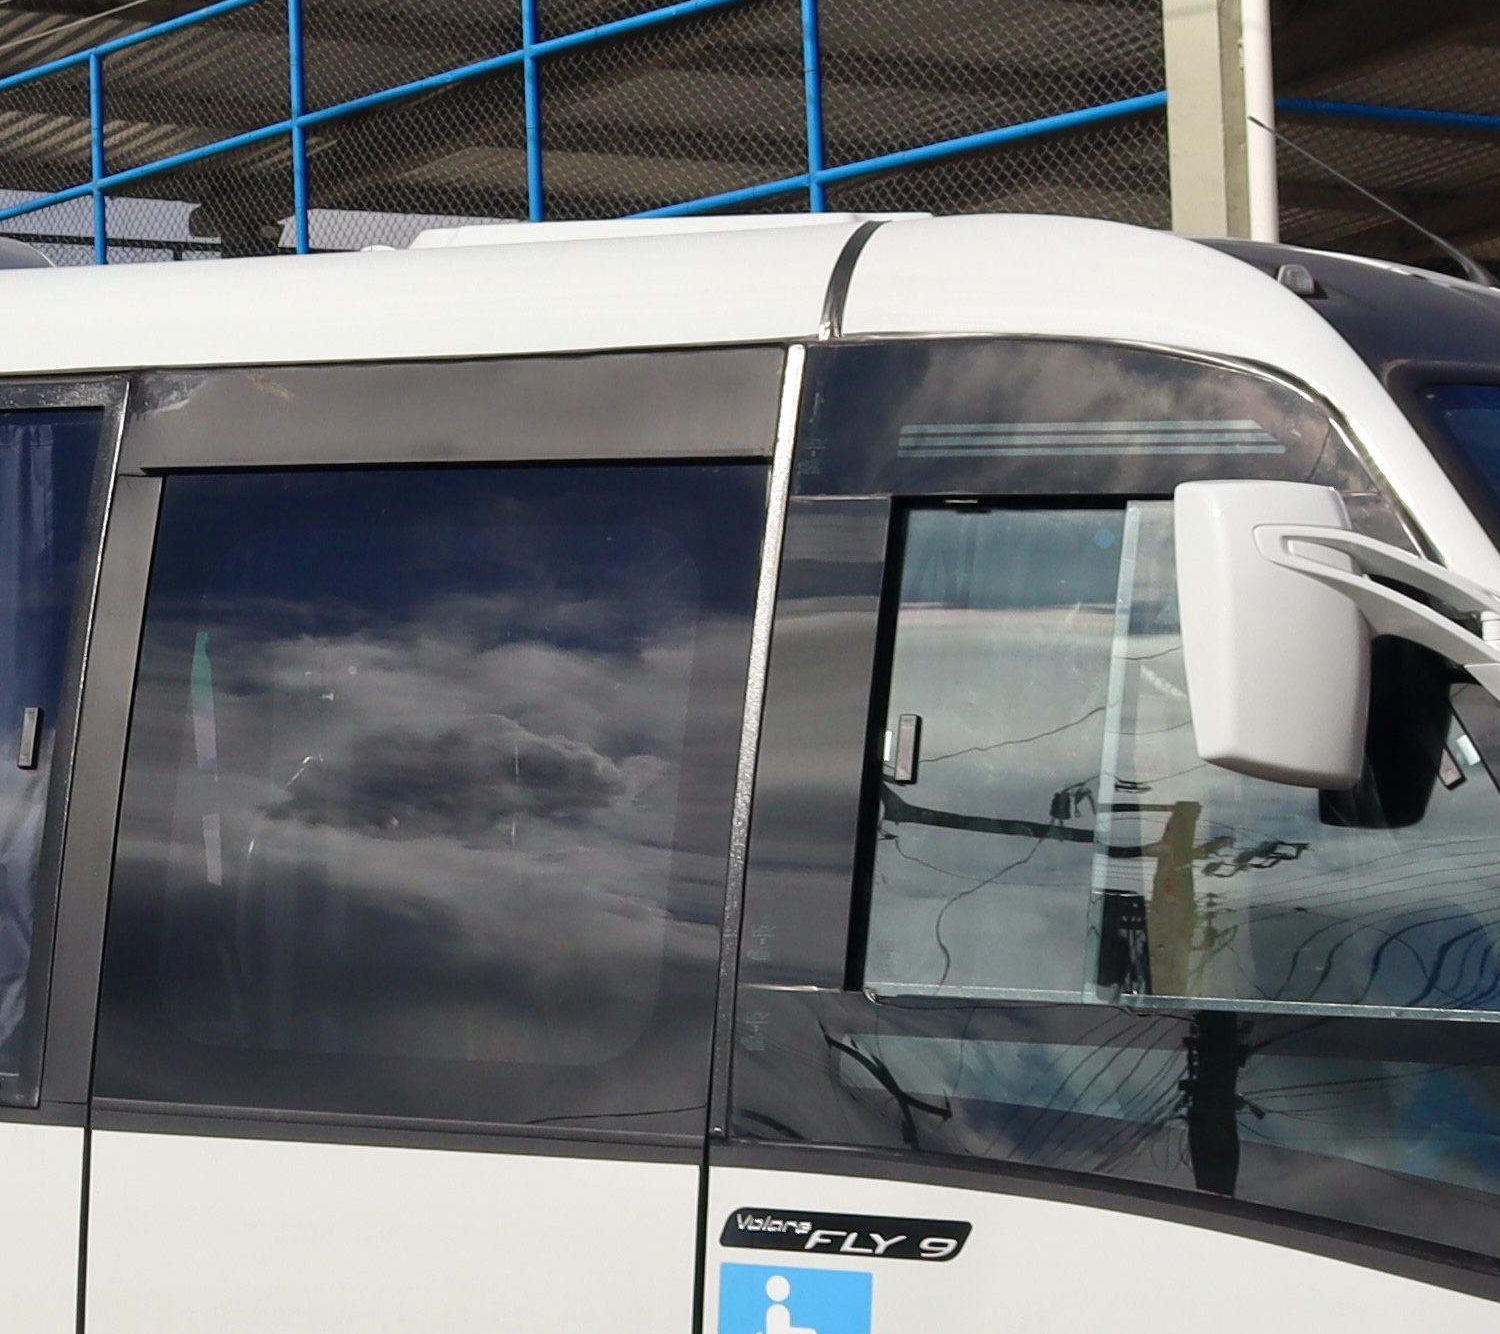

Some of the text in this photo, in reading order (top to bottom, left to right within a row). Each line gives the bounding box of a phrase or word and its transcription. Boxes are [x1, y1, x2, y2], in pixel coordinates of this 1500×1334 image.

[736, 1213, 813, 1234] Volare
[803, 1229, 959, 1258] FLY 9
